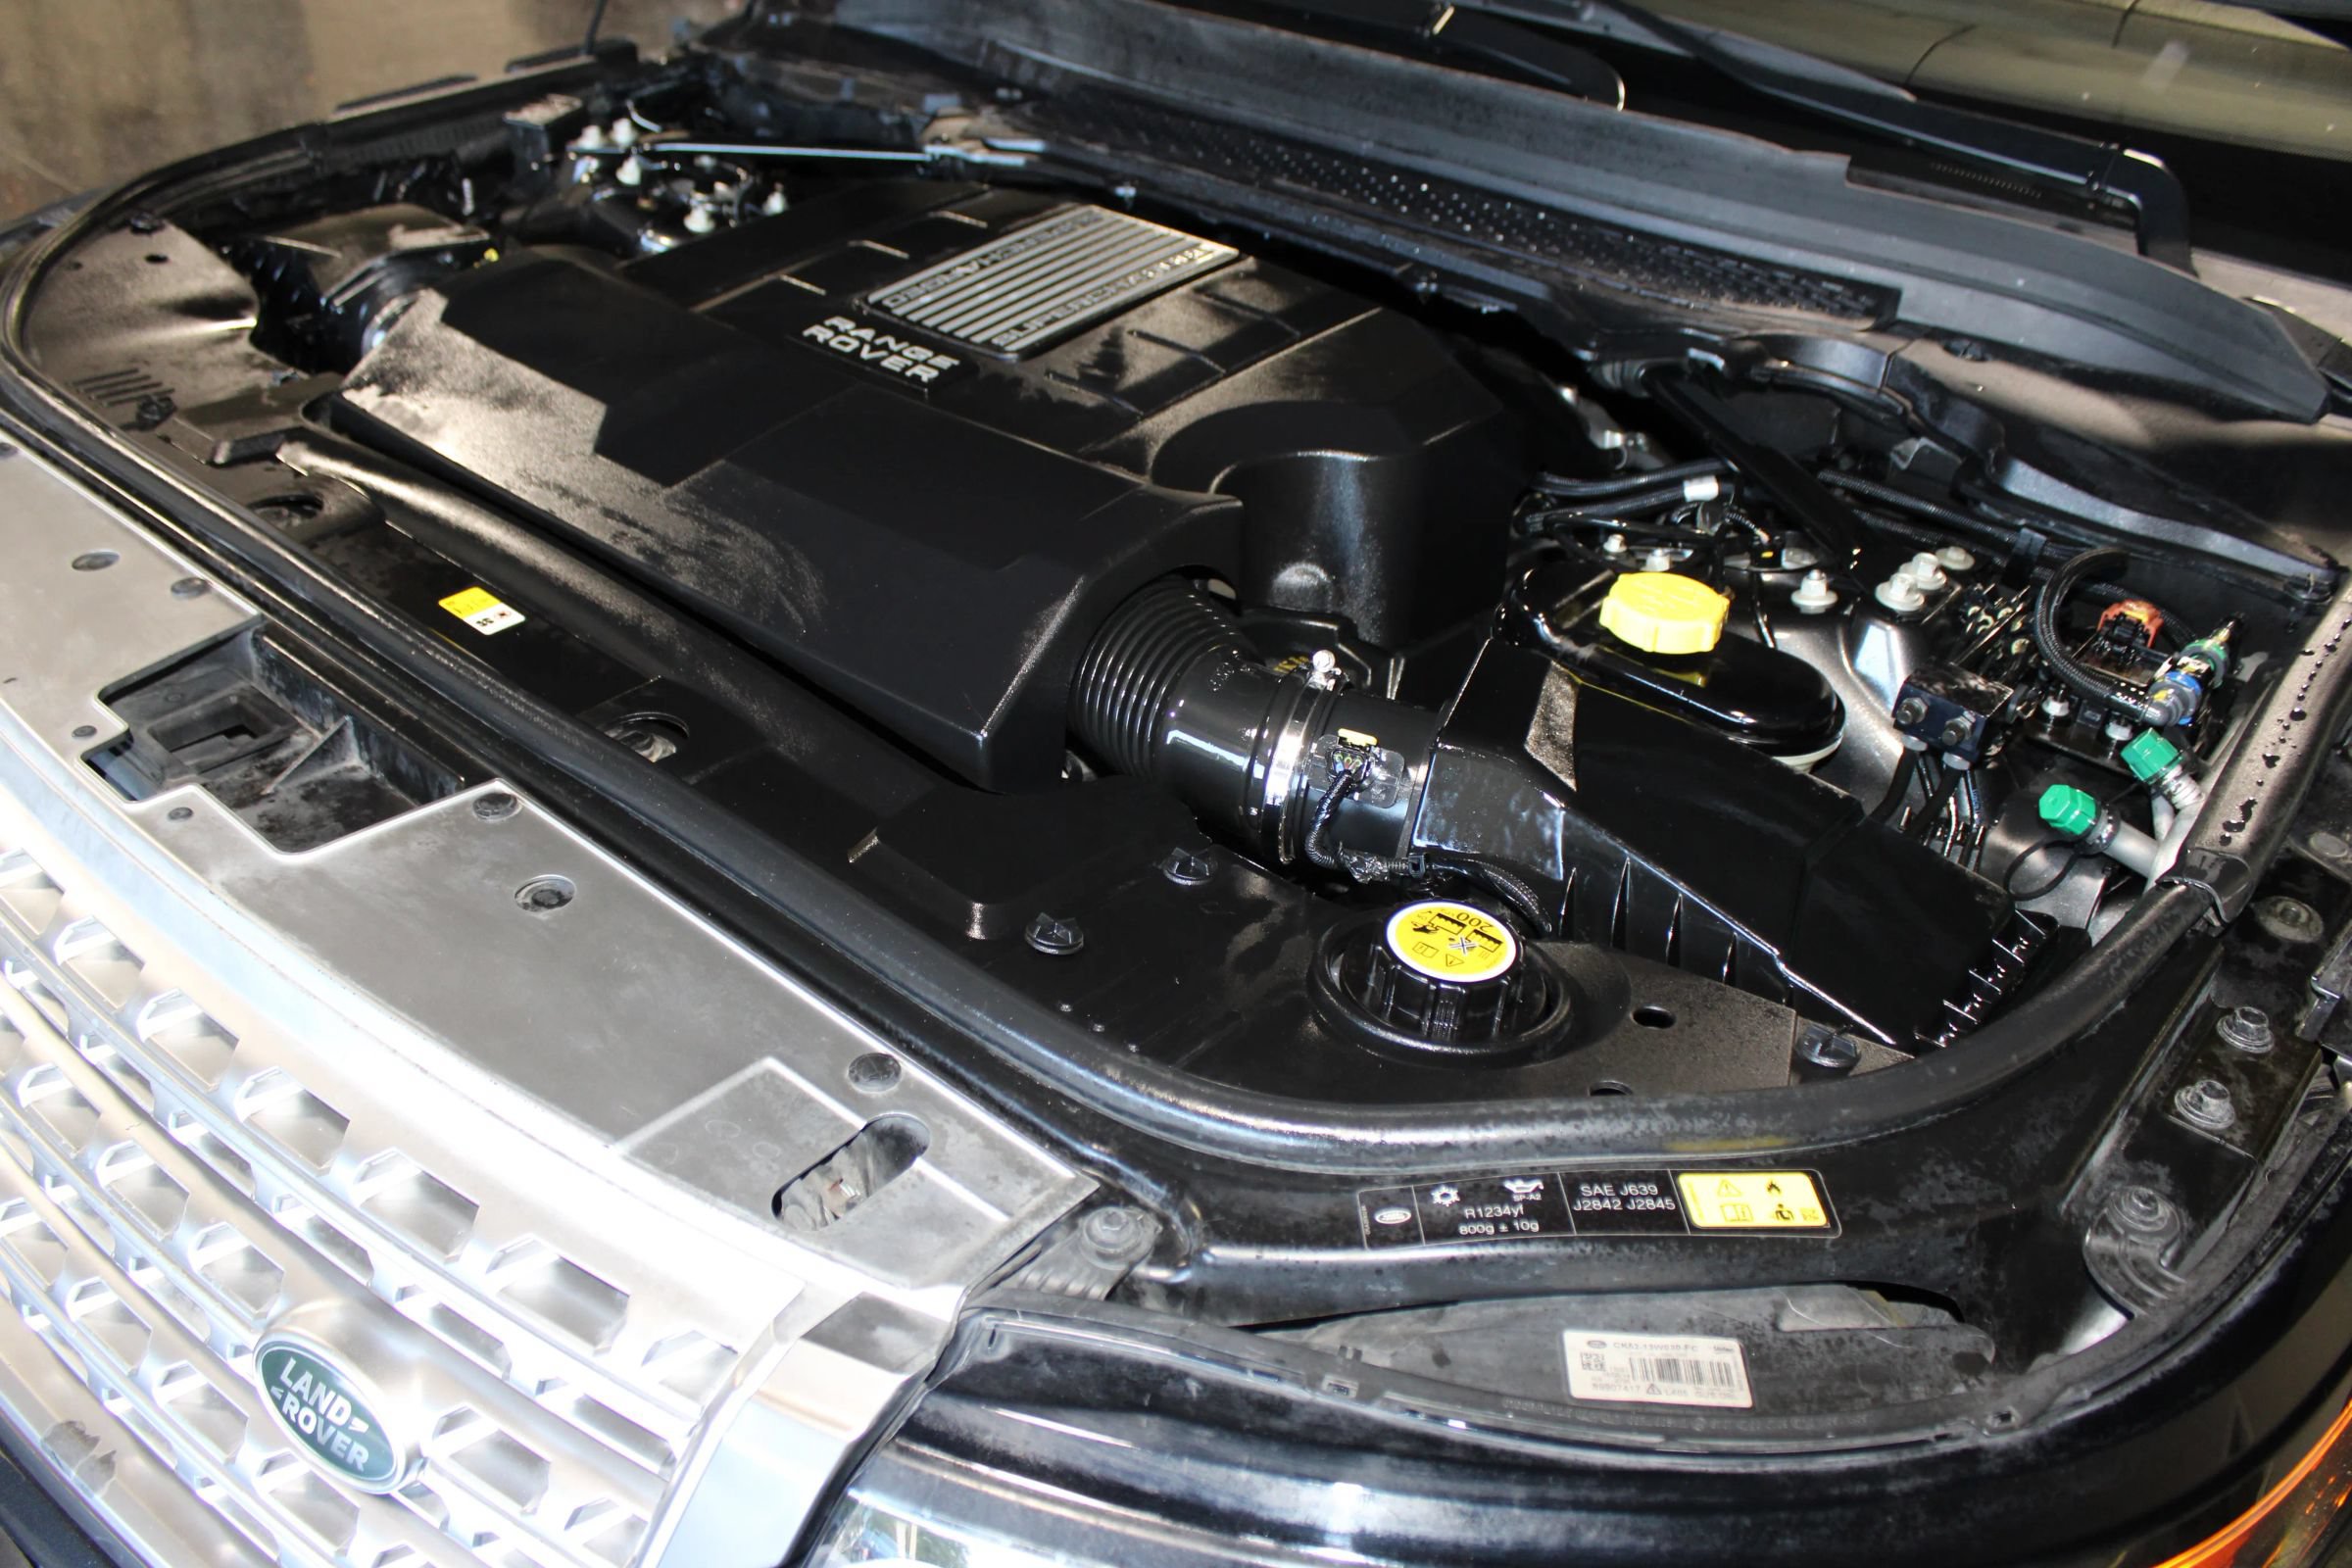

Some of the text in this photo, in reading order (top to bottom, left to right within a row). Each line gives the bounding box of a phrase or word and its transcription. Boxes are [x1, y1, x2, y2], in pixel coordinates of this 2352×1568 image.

[802, 323, 940, 383] ROVER
[822, 316, 960, 370] RANGE
[1456, 911, 1494, 931] 200
[1581, 1182, 1659, 1198] SAE J639
[1464, 1203, 1525, 1220] R1234yf
[1573, 1195, 1677, 1212] J2842 J2845
[1458, 1222, 1495, 1236] 800g
[1513, 1219, 1540, 1234] 10g
[279, 1356, 352, 1427] LAND
[281, 1393, 369, 1473] ROVER
